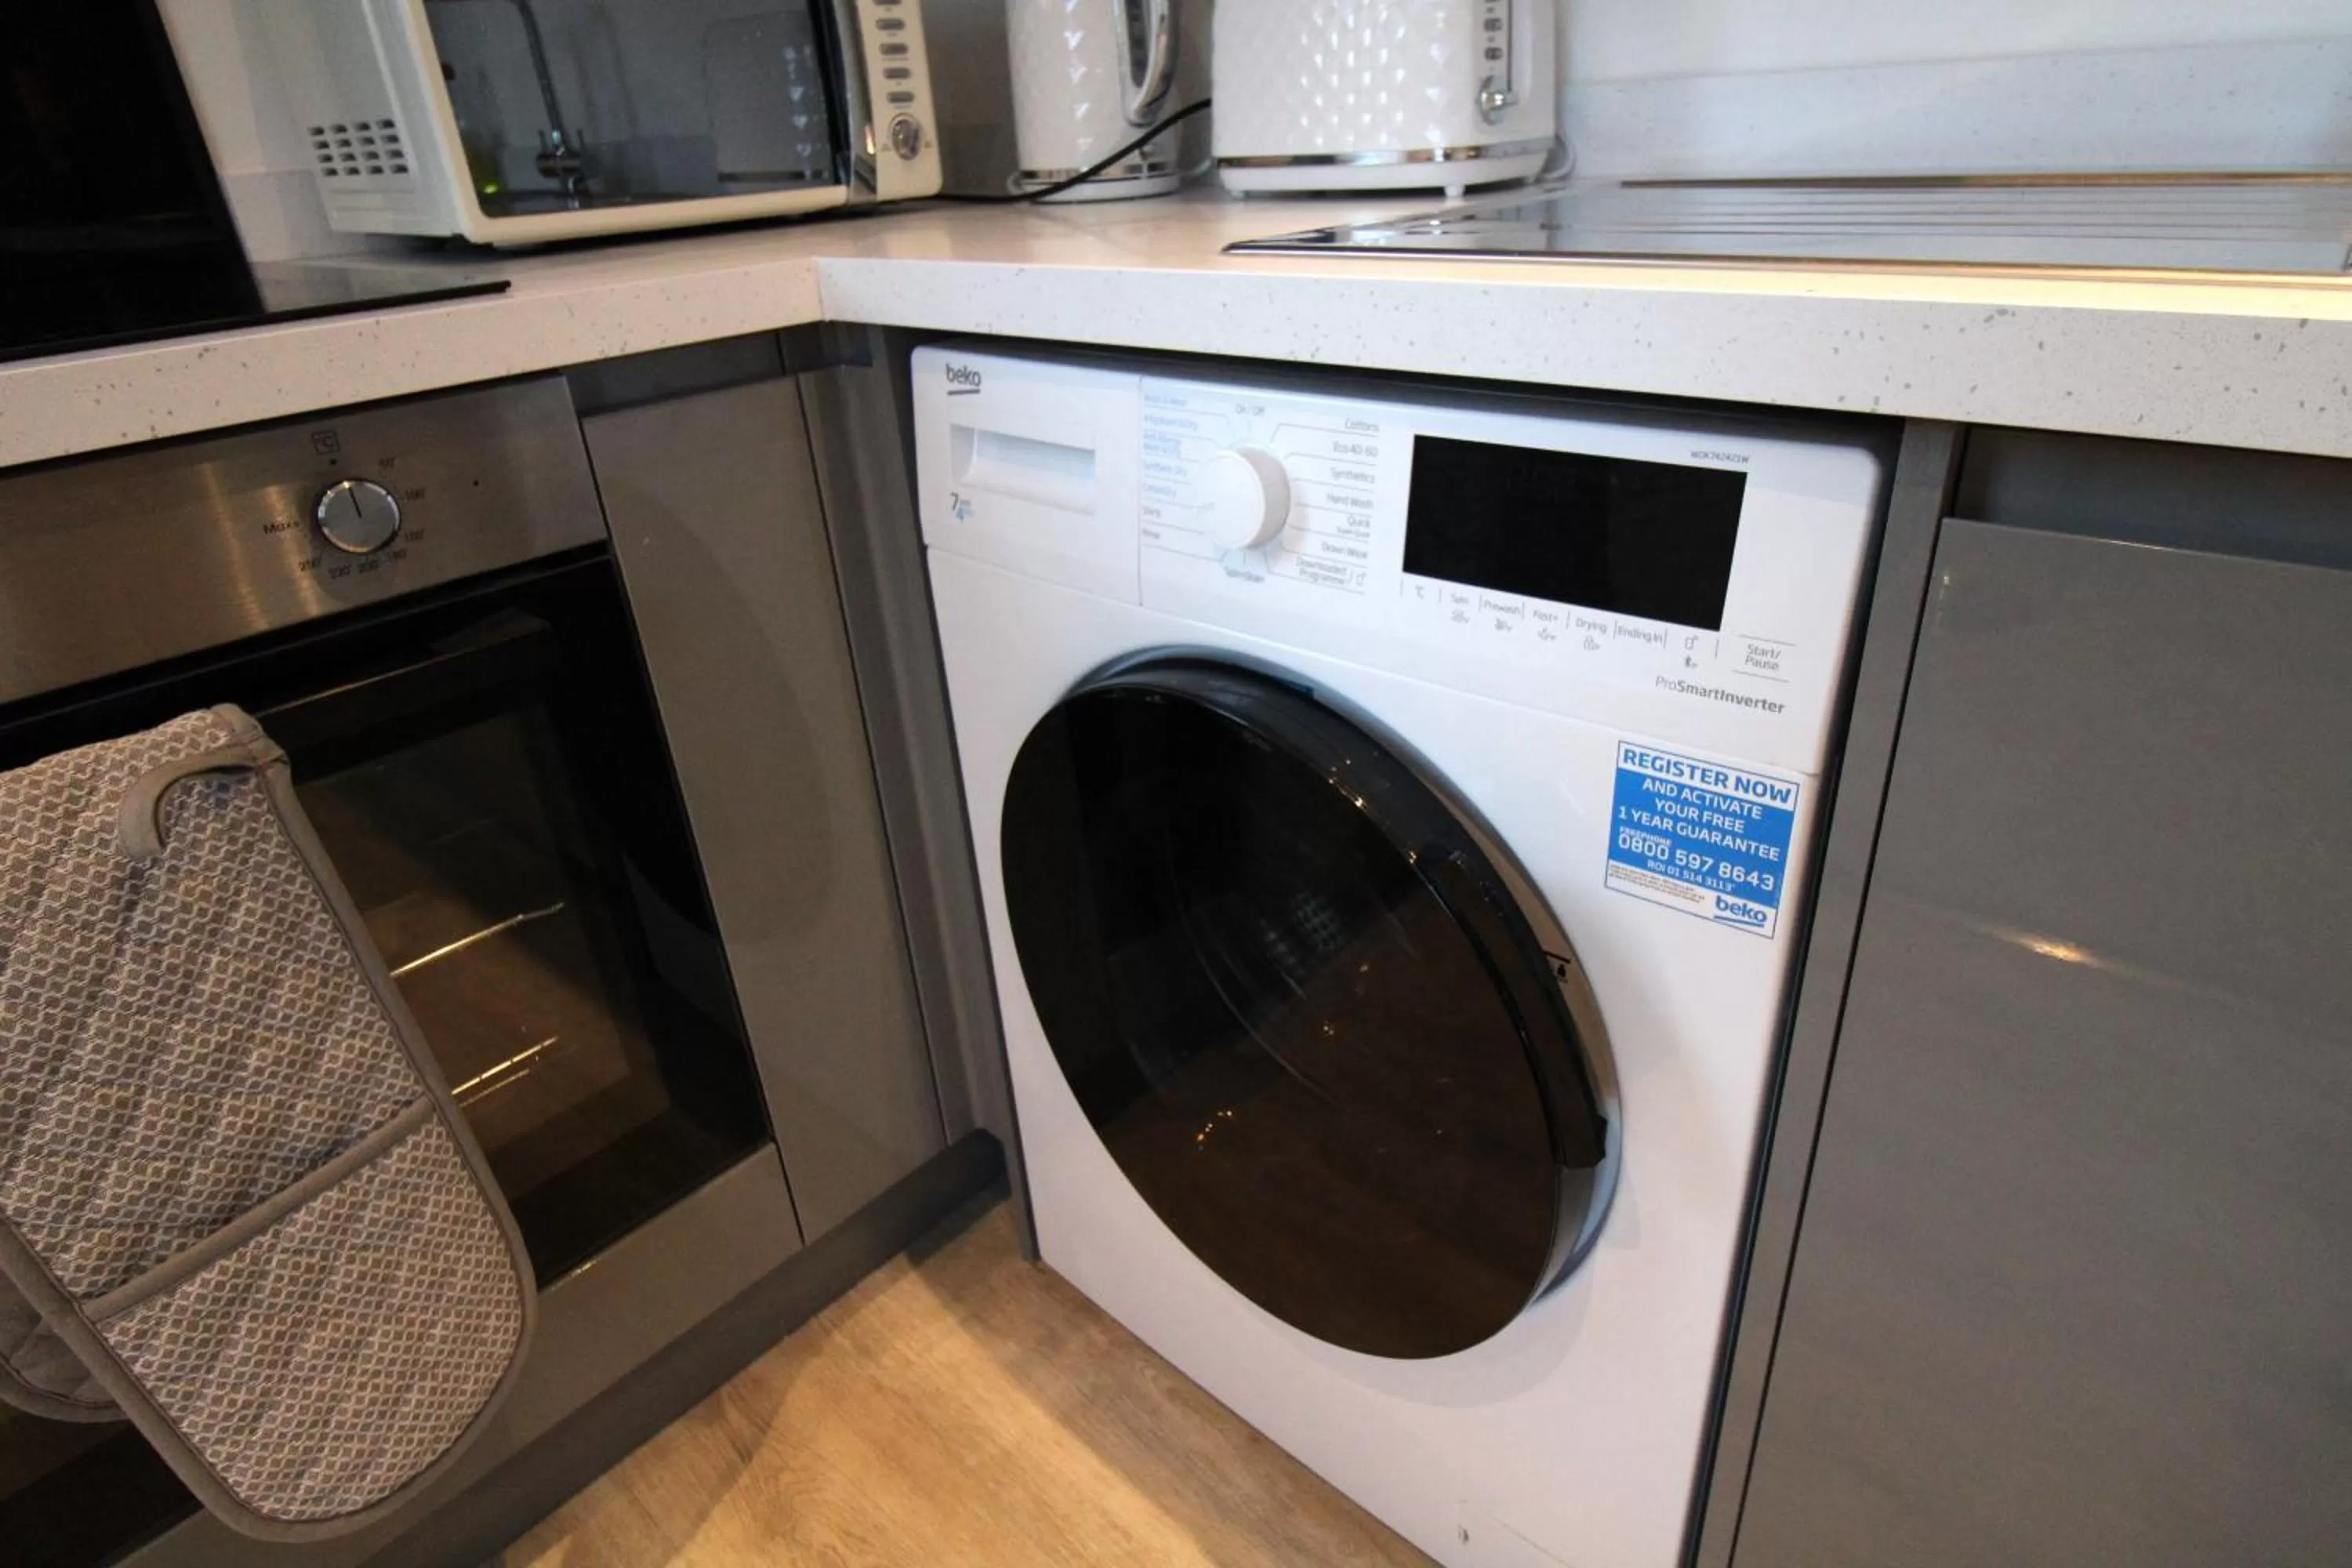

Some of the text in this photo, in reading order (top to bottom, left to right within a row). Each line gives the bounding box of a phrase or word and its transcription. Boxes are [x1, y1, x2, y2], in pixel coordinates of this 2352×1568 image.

[946, 363, 982, 387] beko
[1345, 416, 1380, 432] Cottons
[1575, 617, 1607, 634] Drying
[1617, 625, 1652, 643] Ending
[1744, 655, 1780, 670] Pause
[1748, 642, 1782, 660] Start/
[1655, 675, 1785, 713] ProSmartInverter
[1623, 748, 1791, 804] REGISTER NOW
[1642, 778, 1763, 819] AND ACTIVATE
[1654, 798, 1744, 833] YOUR FREE
[1618, 806, 1780, 862] 1 YEAR GUARANTEE
[1618, 834, 1669, 860] 0800
[1675, 850, 1714, 873] 597
[1718, 862, 1775, 891] 8643
[1647, 860, 1666, 873] ROI
[1682, 869, 1703, 883] 514
[1715, 895, 1768, 923] beko
